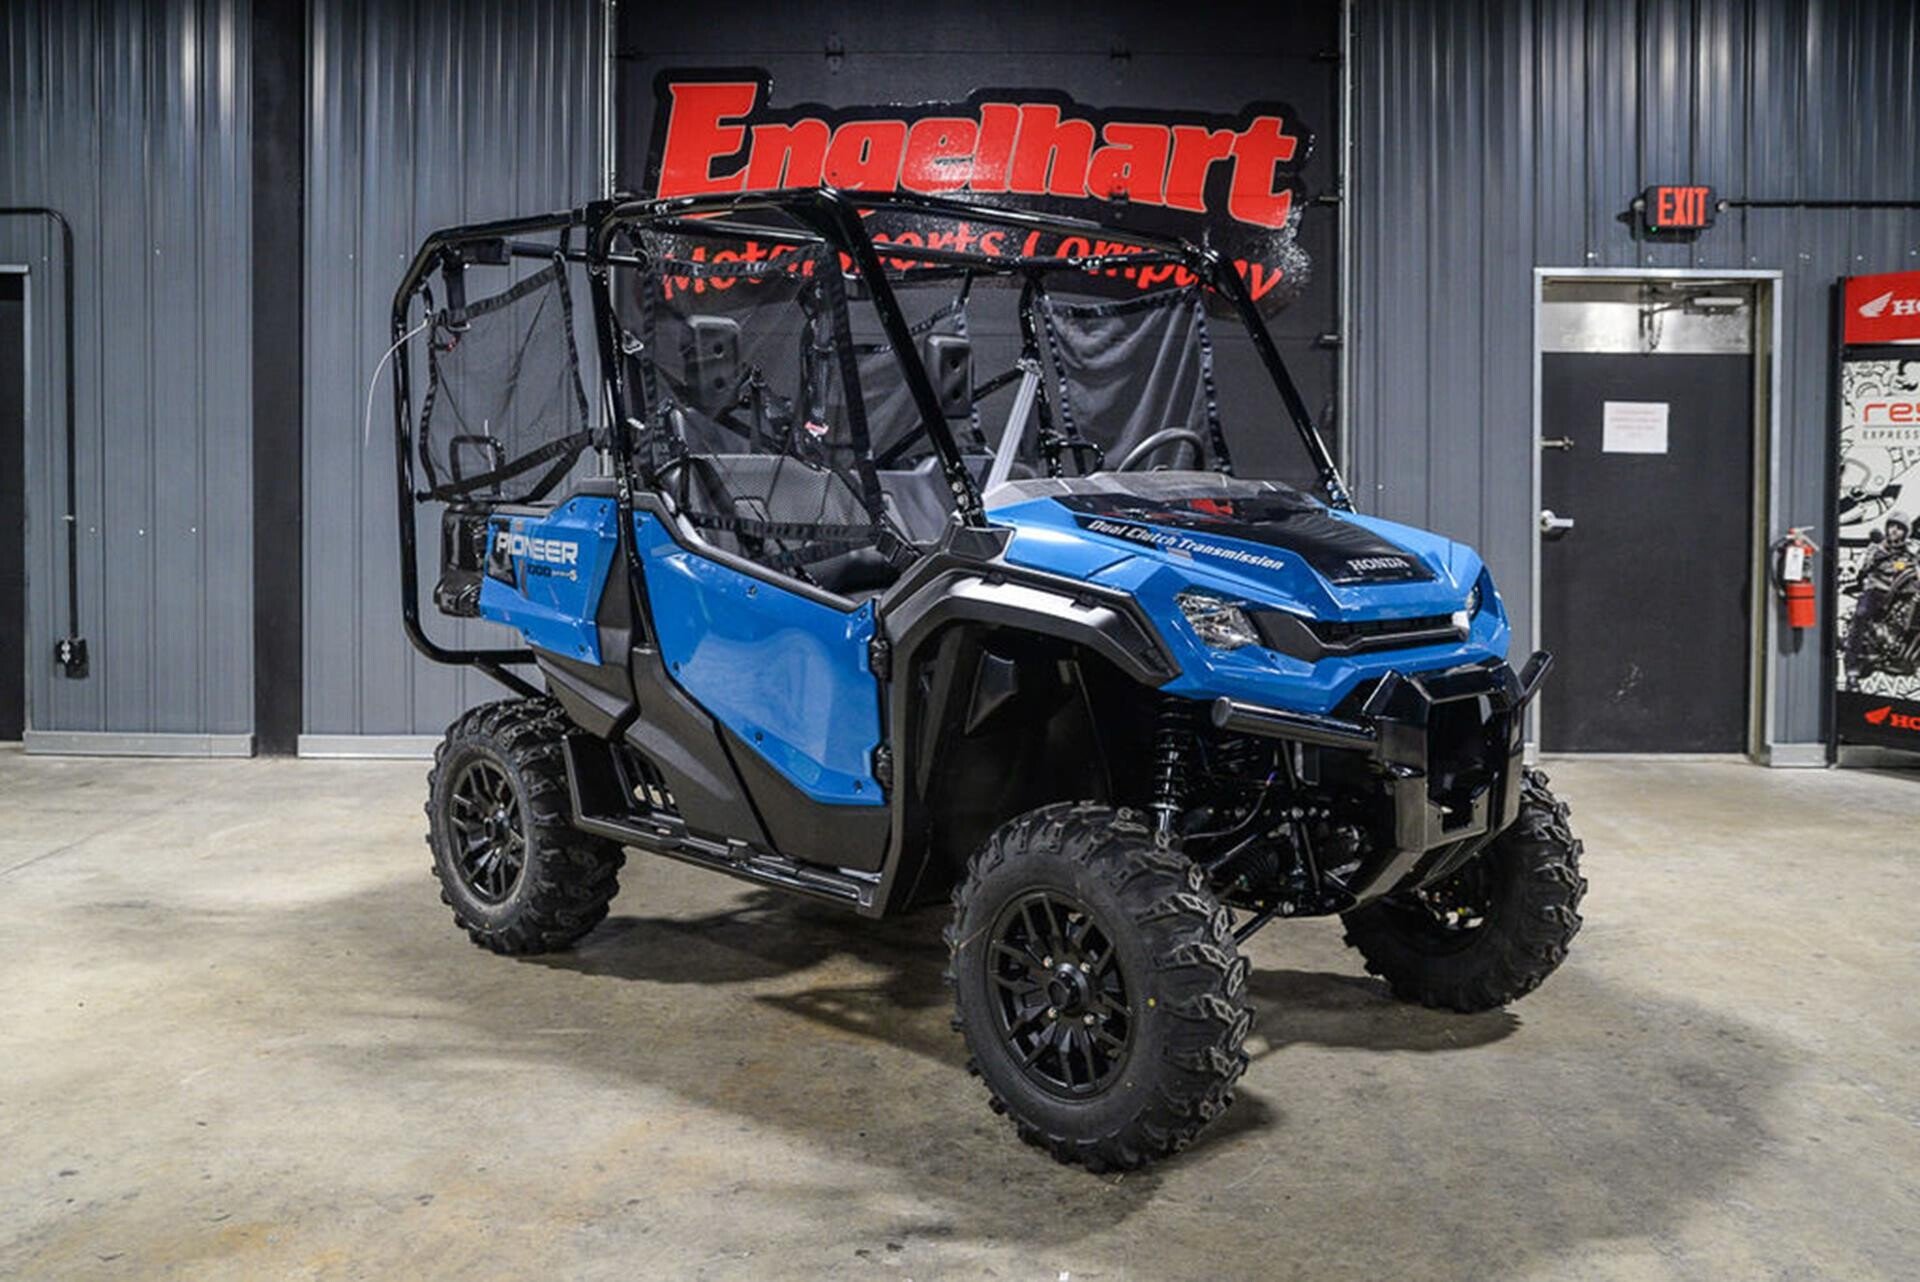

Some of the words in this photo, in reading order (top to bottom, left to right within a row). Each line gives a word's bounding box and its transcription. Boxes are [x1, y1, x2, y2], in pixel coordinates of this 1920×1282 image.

[656, 82, 1298, 228] Engelhart
[1657, 186, 1710, 226] EXIT
[1863, 402, 1920, 422] re
[496, 531, 579, 566] PIONEER
[1087, 519, 1129, 536] Dual
[1125, 526, 1178, 547] Clutch
[1177, 536, 1285, 571] Transmission
[1345, 556, 1411, 572] HONDA
